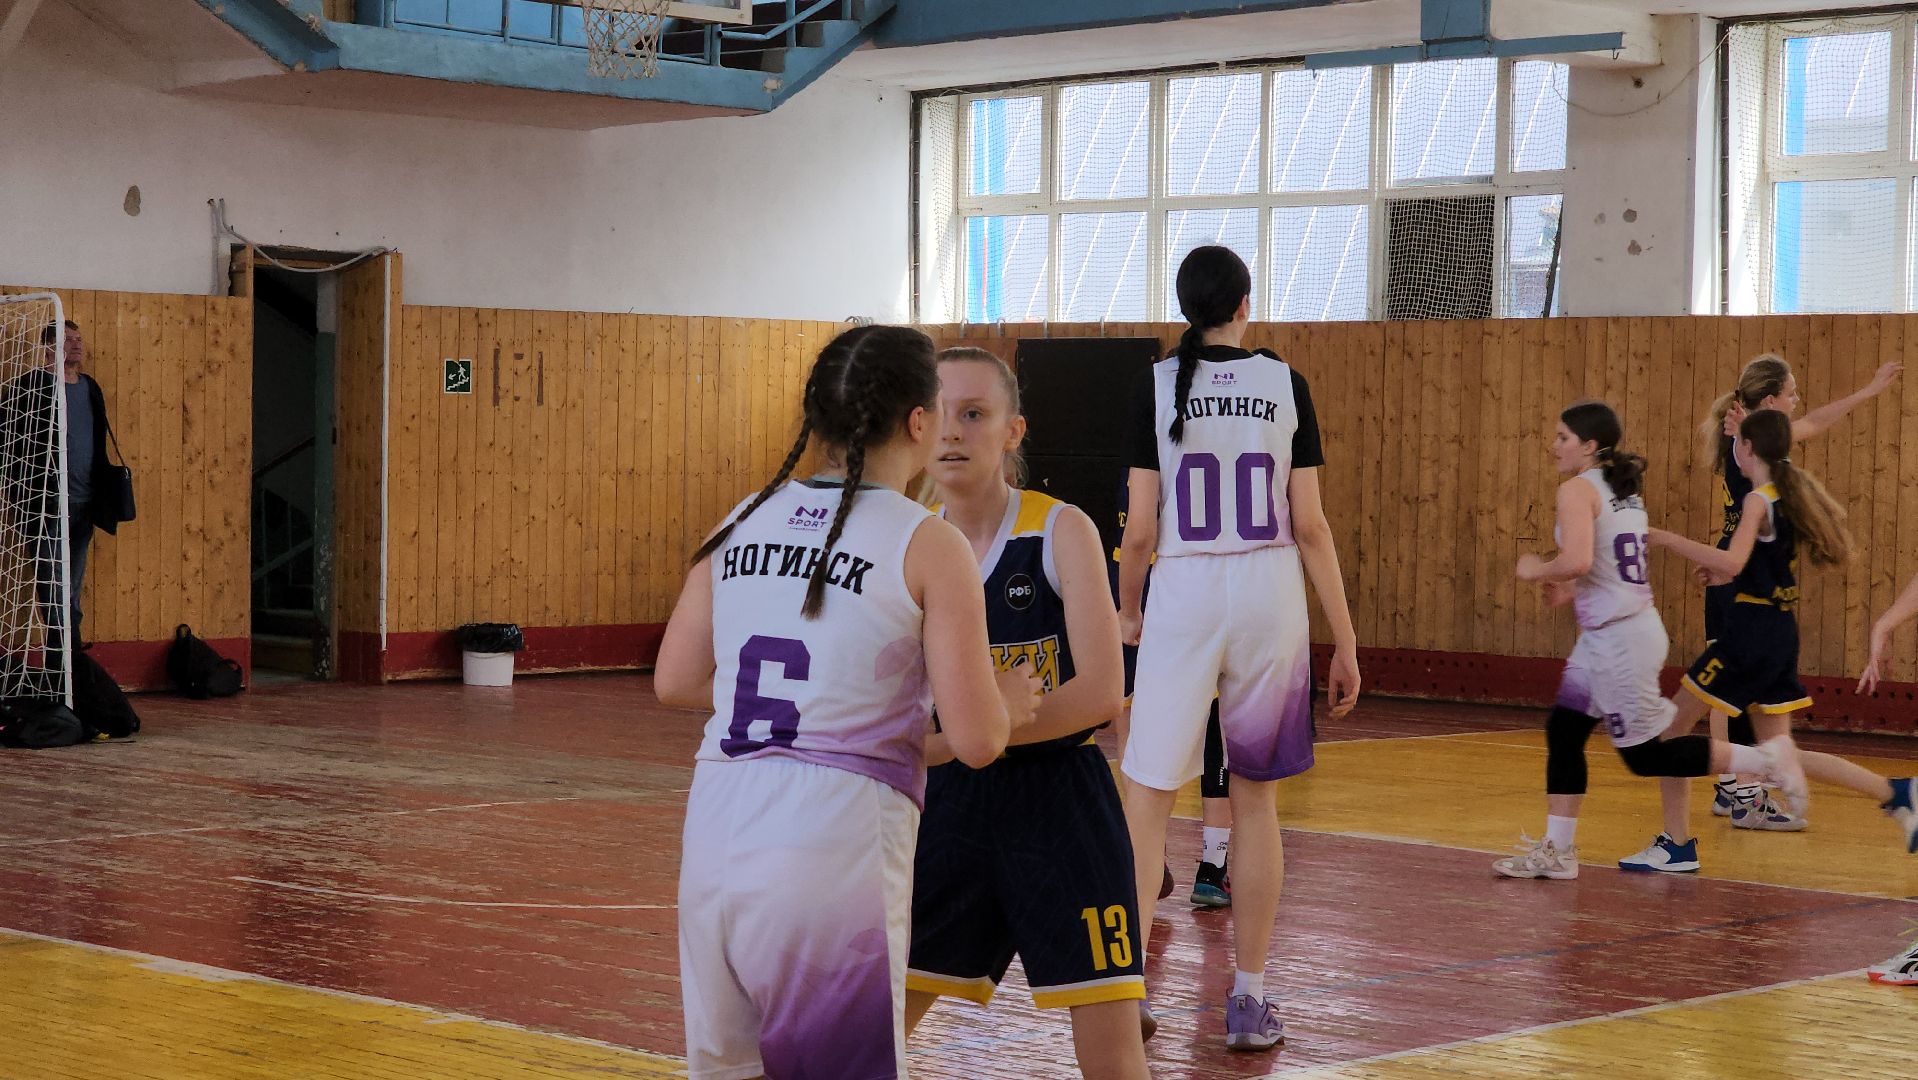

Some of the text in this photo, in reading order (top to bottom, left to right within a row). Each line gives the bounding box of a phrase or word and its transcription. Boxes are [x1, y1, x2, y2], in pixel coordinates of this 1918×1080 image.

[1175, 452, 1279, 542] 00
[787, 517, 828, 528] SPORT
[1008, 585, 1032, 598] РФБ
[1697, 658, 1724, 686] 5
[719, 634, 812, 759] 6
[1080, 904, 1134, 972] 13
